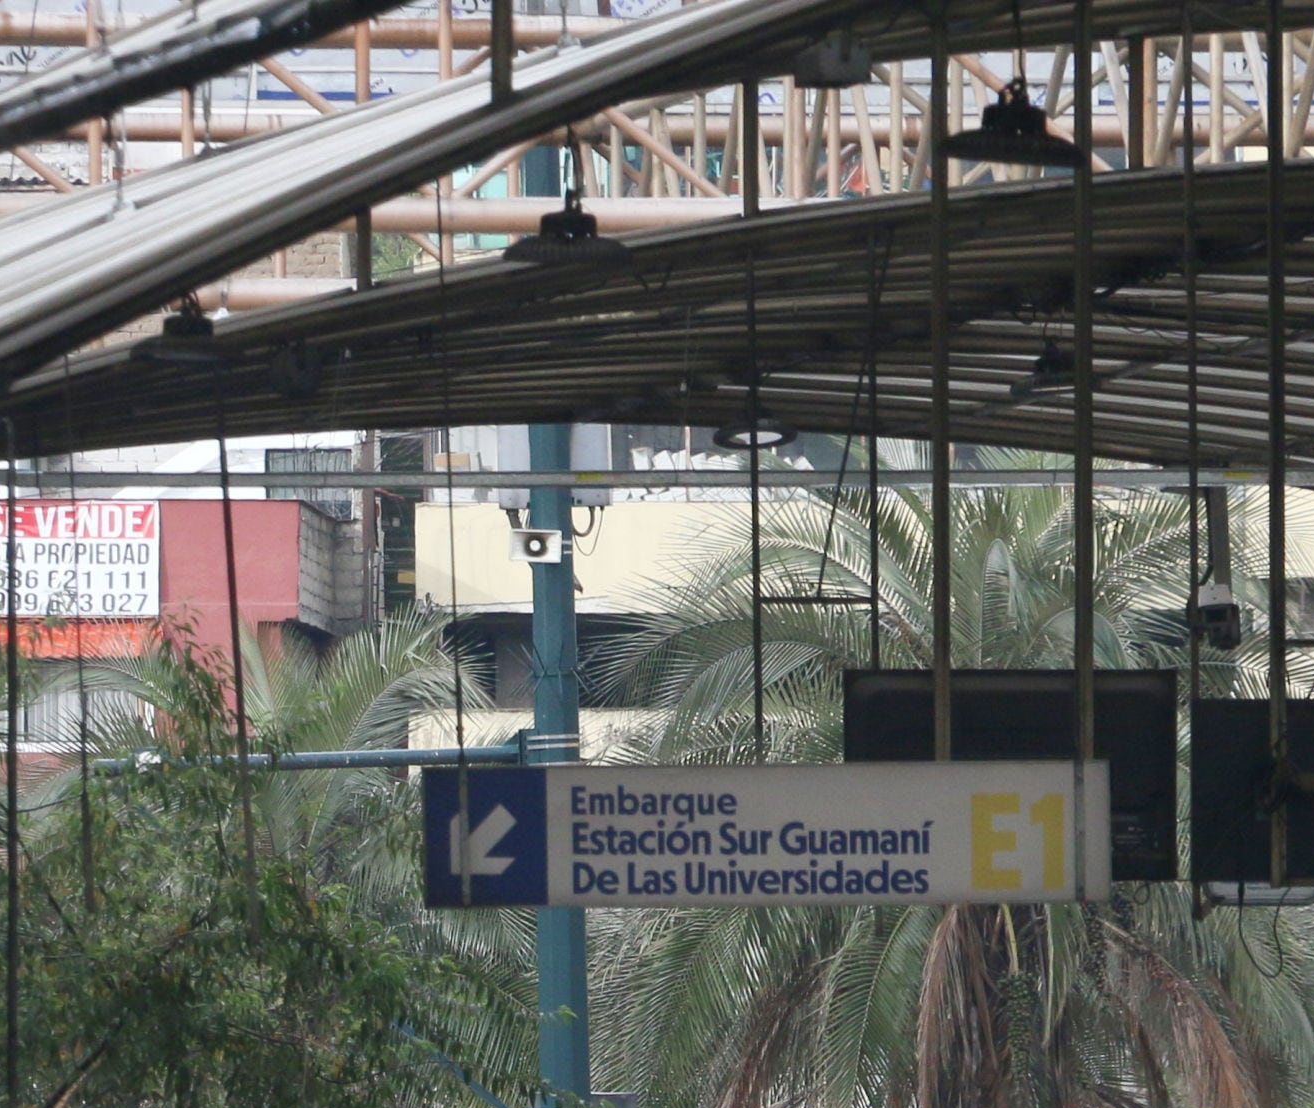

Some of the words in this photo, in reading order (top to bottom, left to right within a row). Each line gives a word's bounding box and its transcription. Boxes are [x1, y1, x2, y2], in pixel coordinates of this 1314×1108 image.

[34, 505, 145, 538] VENDE
[34, 542, 150, 565] PROPIEDAD
[105, 571, 147, 590] 111
[102, 593, 149, 613] 027
[571, 785, 737, 822] Embarque
[571, 820, 712, 856] Estación
[720, 823, 772, 856] Sur
[779, 820, 935, 856] Guamaní
[971, 792, 1066, 890] E1
[573, 861, 618, 895] De
[628, 861, 677, 895] Las
[685, 860, 930, 895] Universidades
